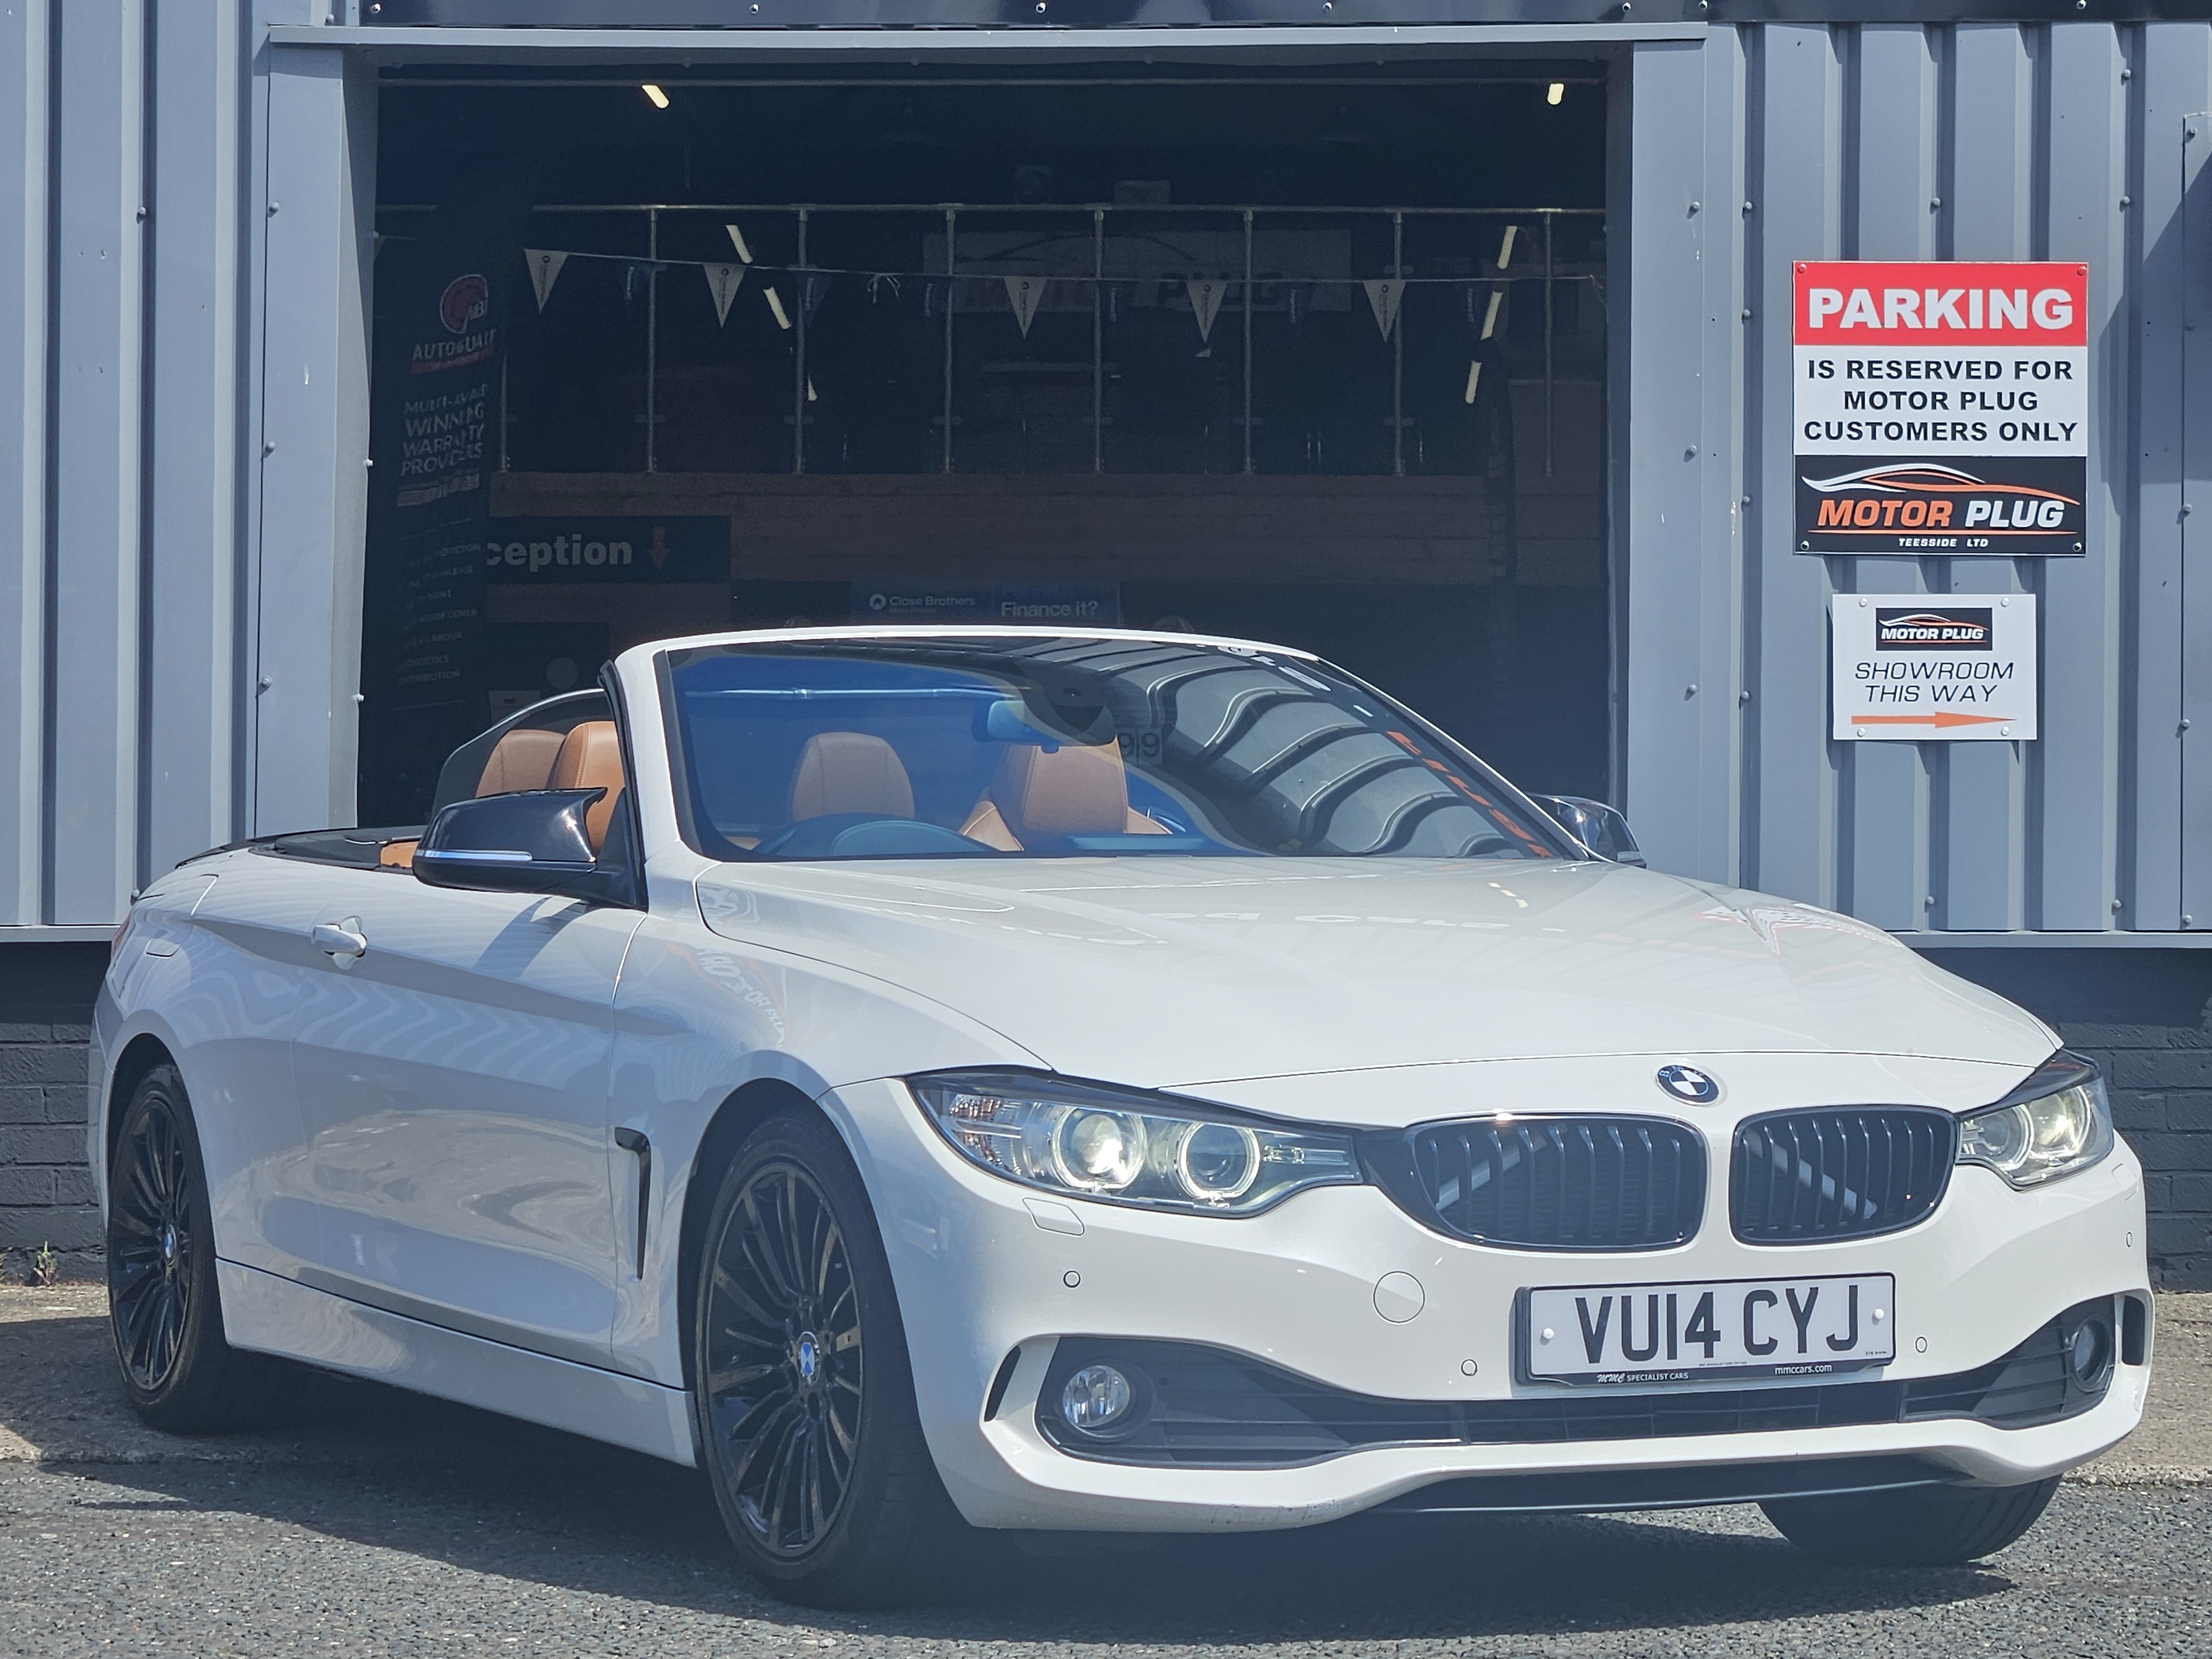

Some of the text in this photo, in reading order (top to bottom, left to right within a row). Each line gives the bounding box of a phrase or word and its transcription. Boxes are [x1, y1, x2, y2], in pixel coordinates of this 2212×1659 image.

[1809, 288, 2073, 330] PARKING
[1808, 359, 2073, 380] IS RESERVED FOR
[1844, 391, 2038, 411] MOTOR PLUG
[1804, 421, 2078, 442] CUSTOMERS ONLY
[1818, 499, 2065, 528] MOTOR PLUG
[1898, 538, 1989, 547] TEESSIDE LTD
[486, 533, 632, 572] ception
[890, 595, 975, 607] Close Brothers
[1001, 601, 1098, 617] Finance it?
[1881, 628, 1984, 640] MOTOR PLUG
[1854, 662, 2014, 680] SHOWROOM
[1865, 685, 1999, 702] THIS WAY
[1574, 1284, 1859, 1364] VU14 CYJ
[1597, 1372, 1689, 1384] MMC SPECIALIST CARS
[1775, 1363, 1833, 1375] mmccars.com
